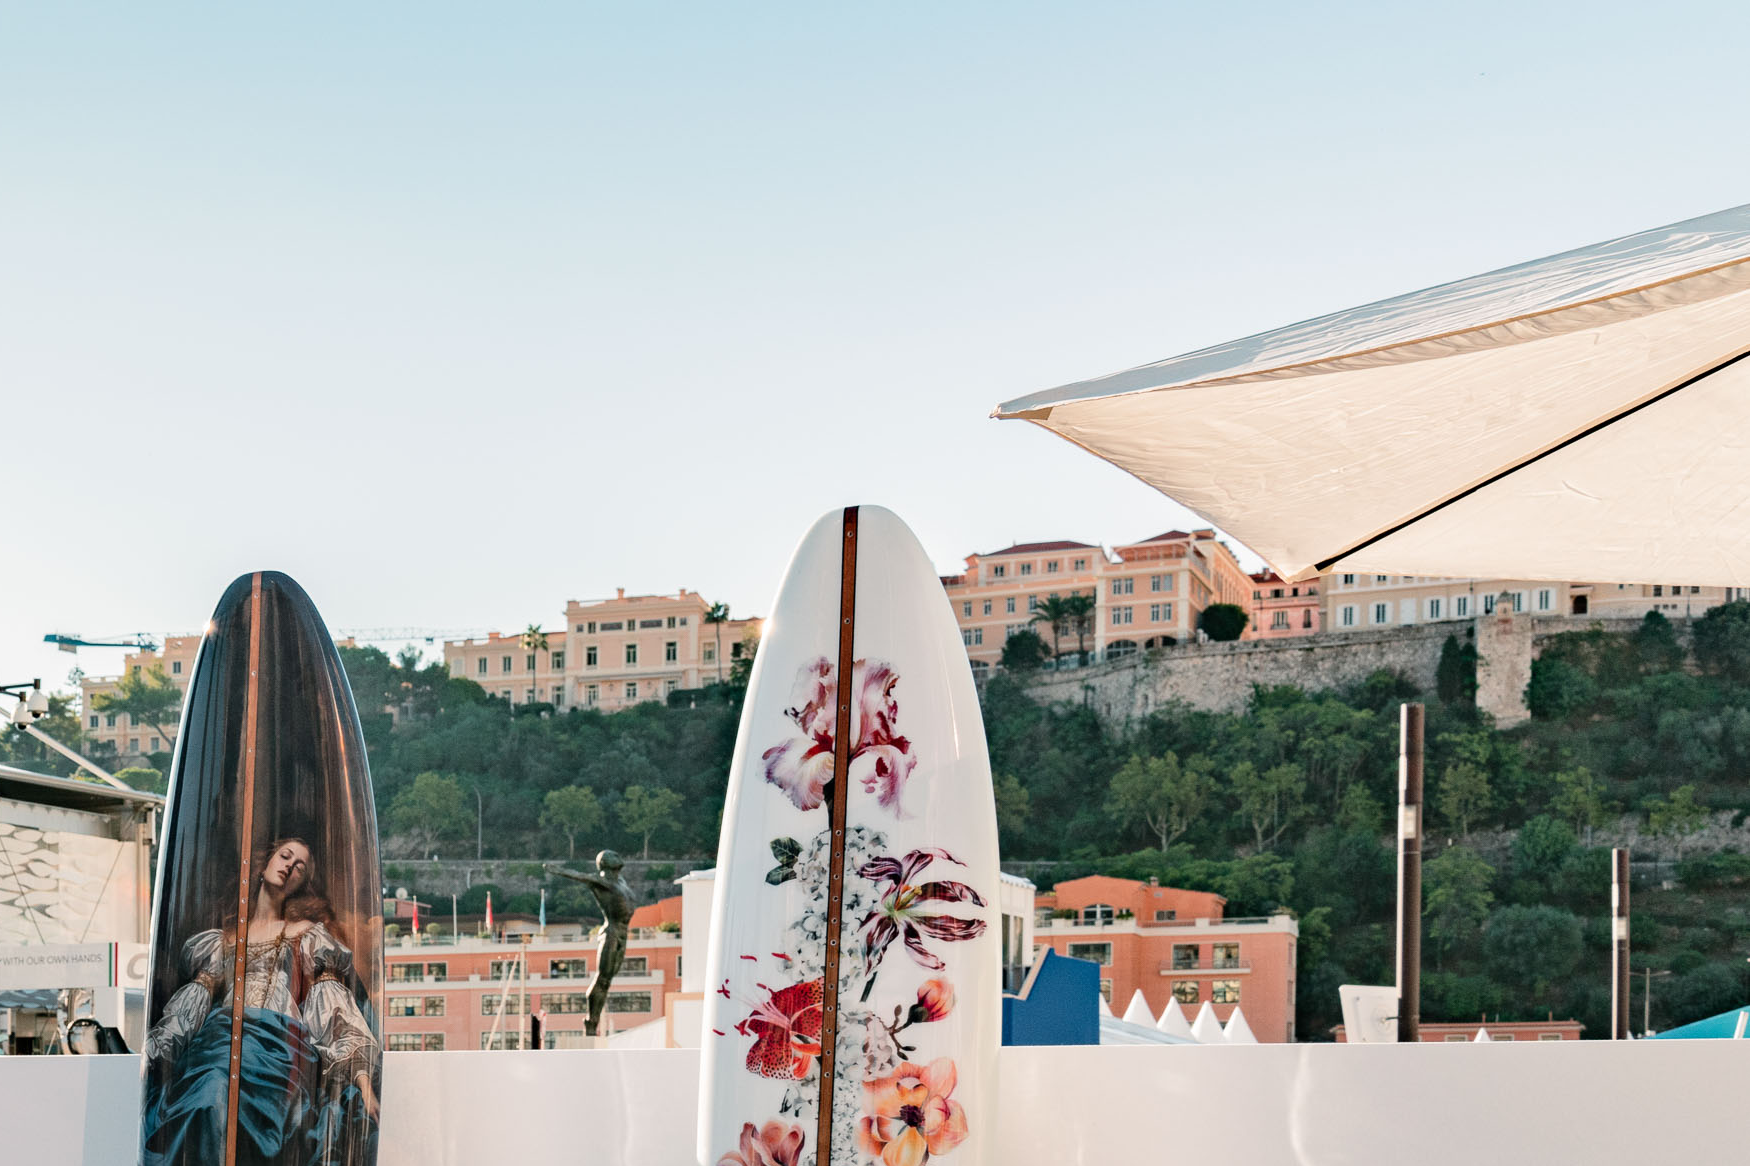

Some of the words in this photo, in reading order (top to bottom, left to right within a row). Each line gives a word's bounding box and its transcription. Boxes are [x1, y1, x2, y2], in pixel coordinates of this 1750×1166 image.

[3, 955, 24, 966] WITH
[25, 955, 45, 966] OUR
[46, 954, 69, 965] OWN
